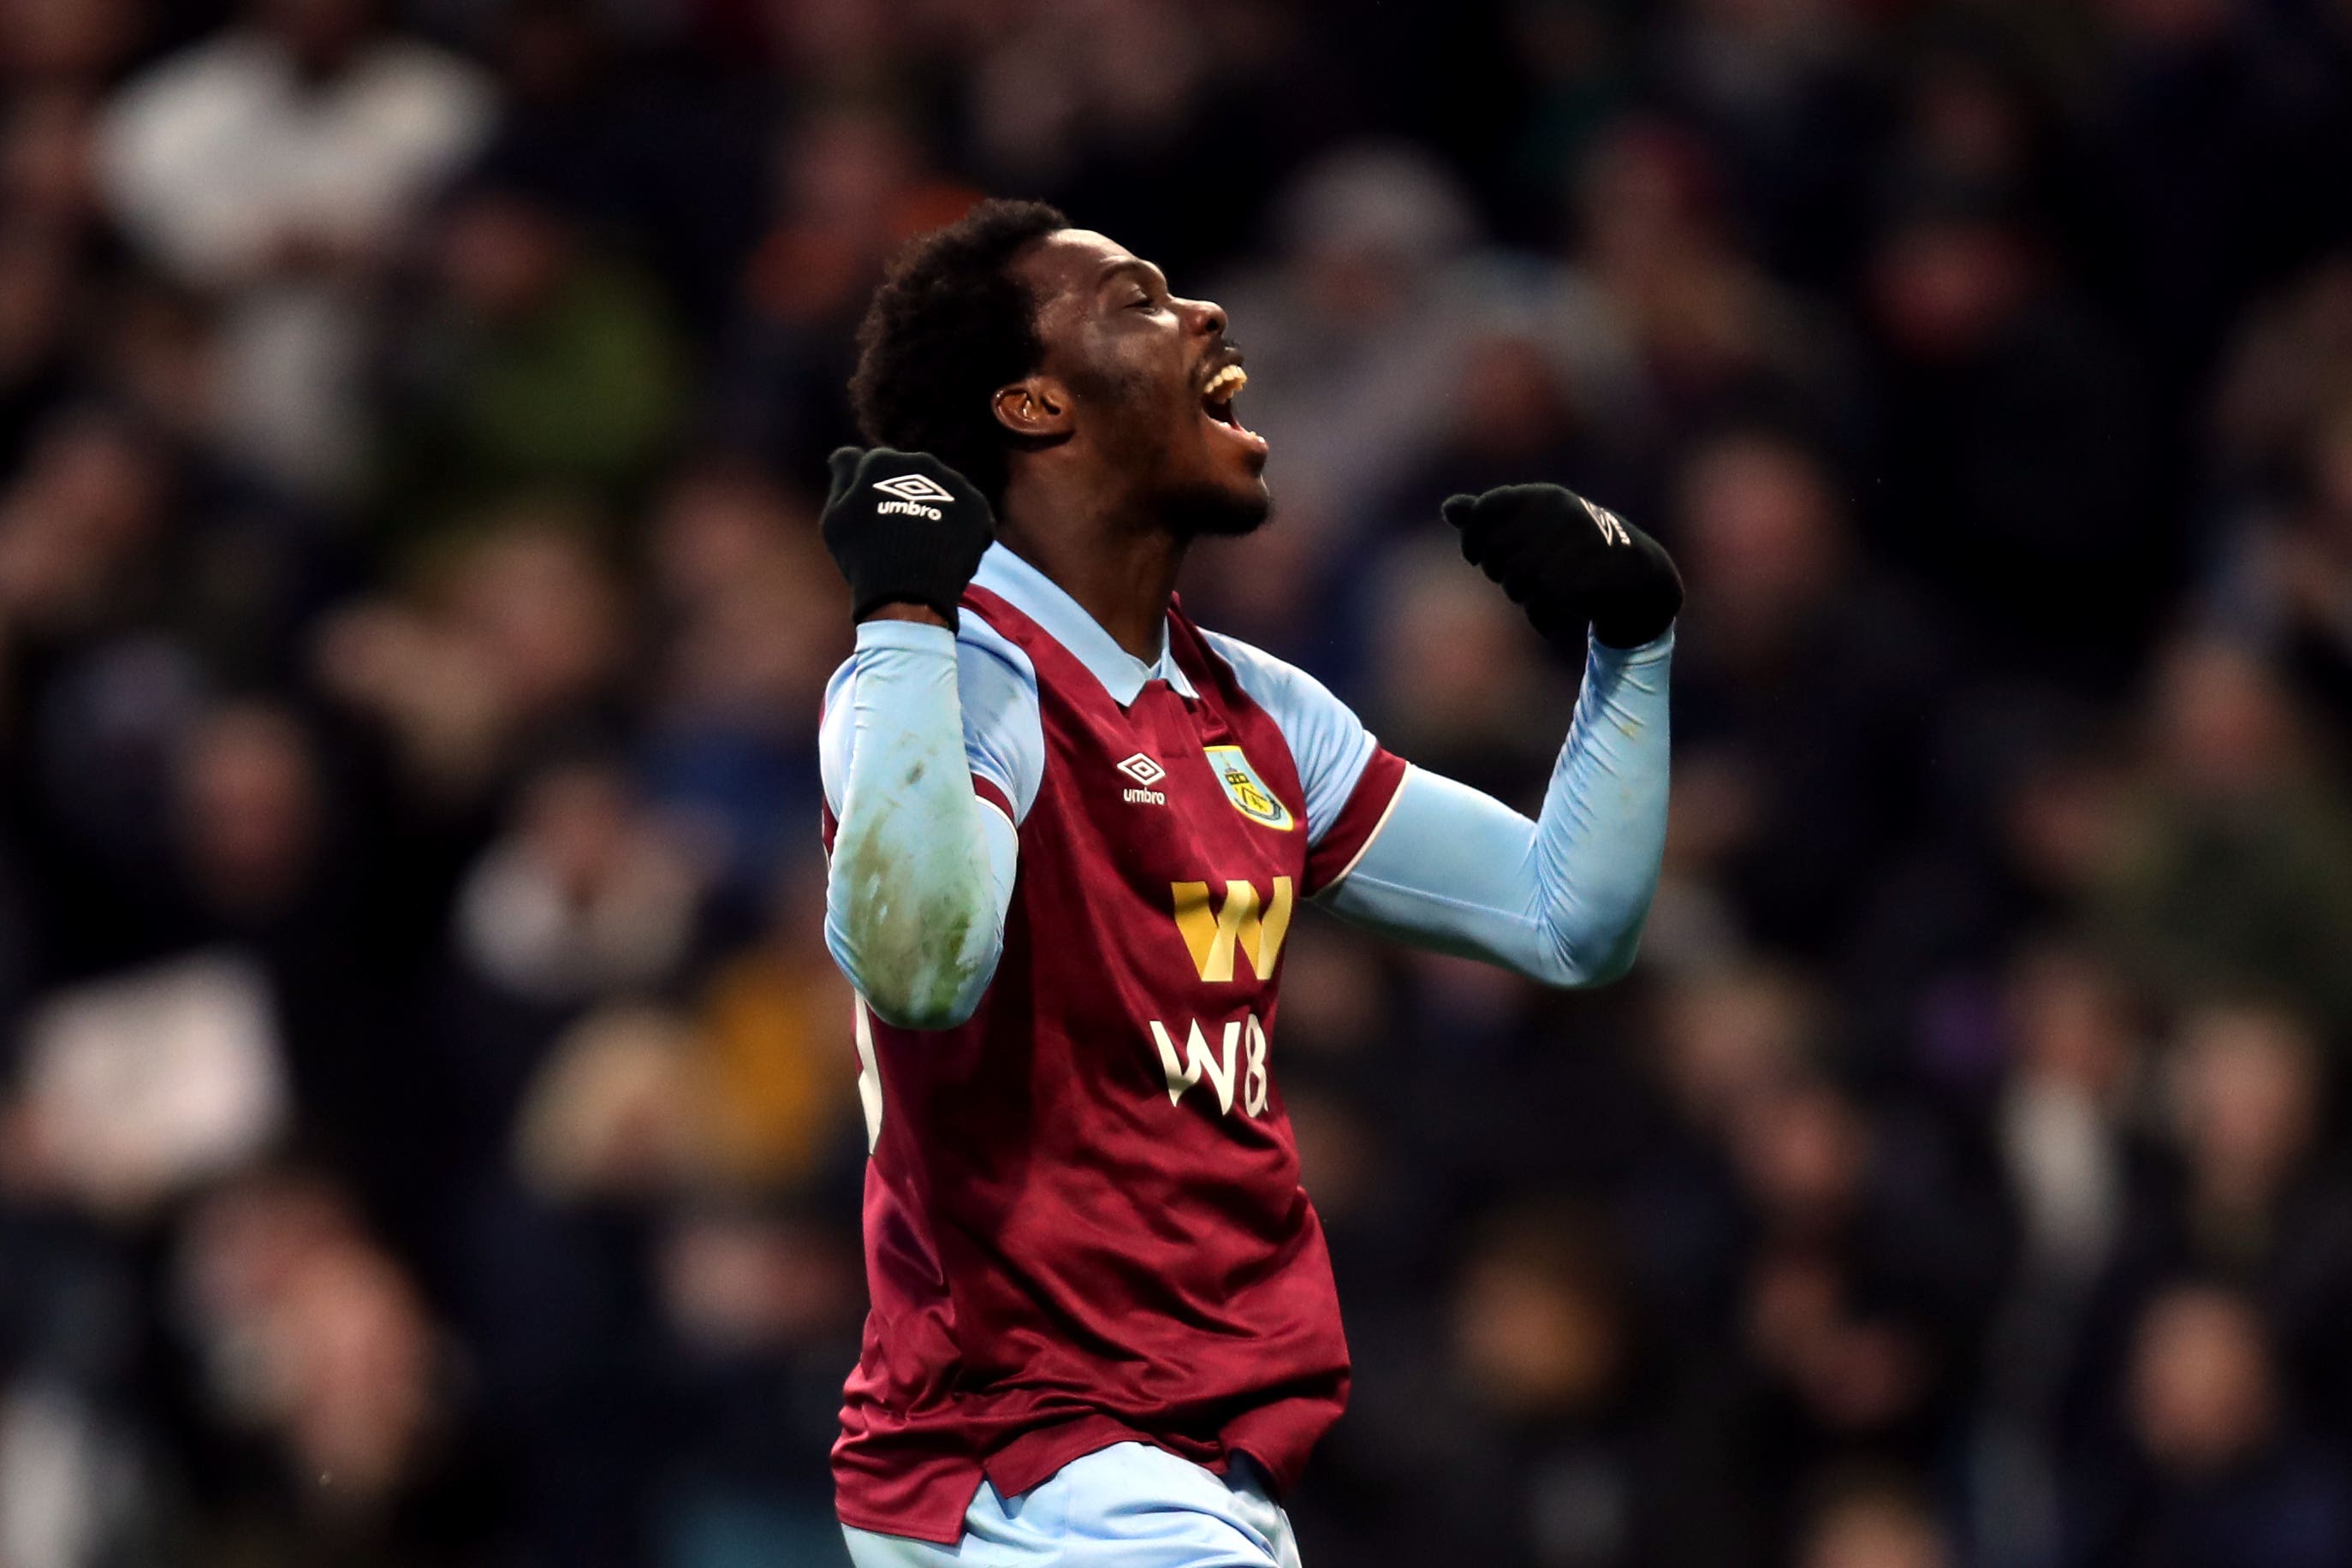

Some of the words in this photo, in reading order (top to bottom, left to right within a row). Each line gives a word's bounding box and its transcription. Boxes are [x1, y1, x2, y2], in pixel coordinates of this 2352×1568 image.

[877, 501, 941, 520] umbro
[1123, 787, 1165, 805] umbro
[1149, 1013, 1268, 1118] W8
